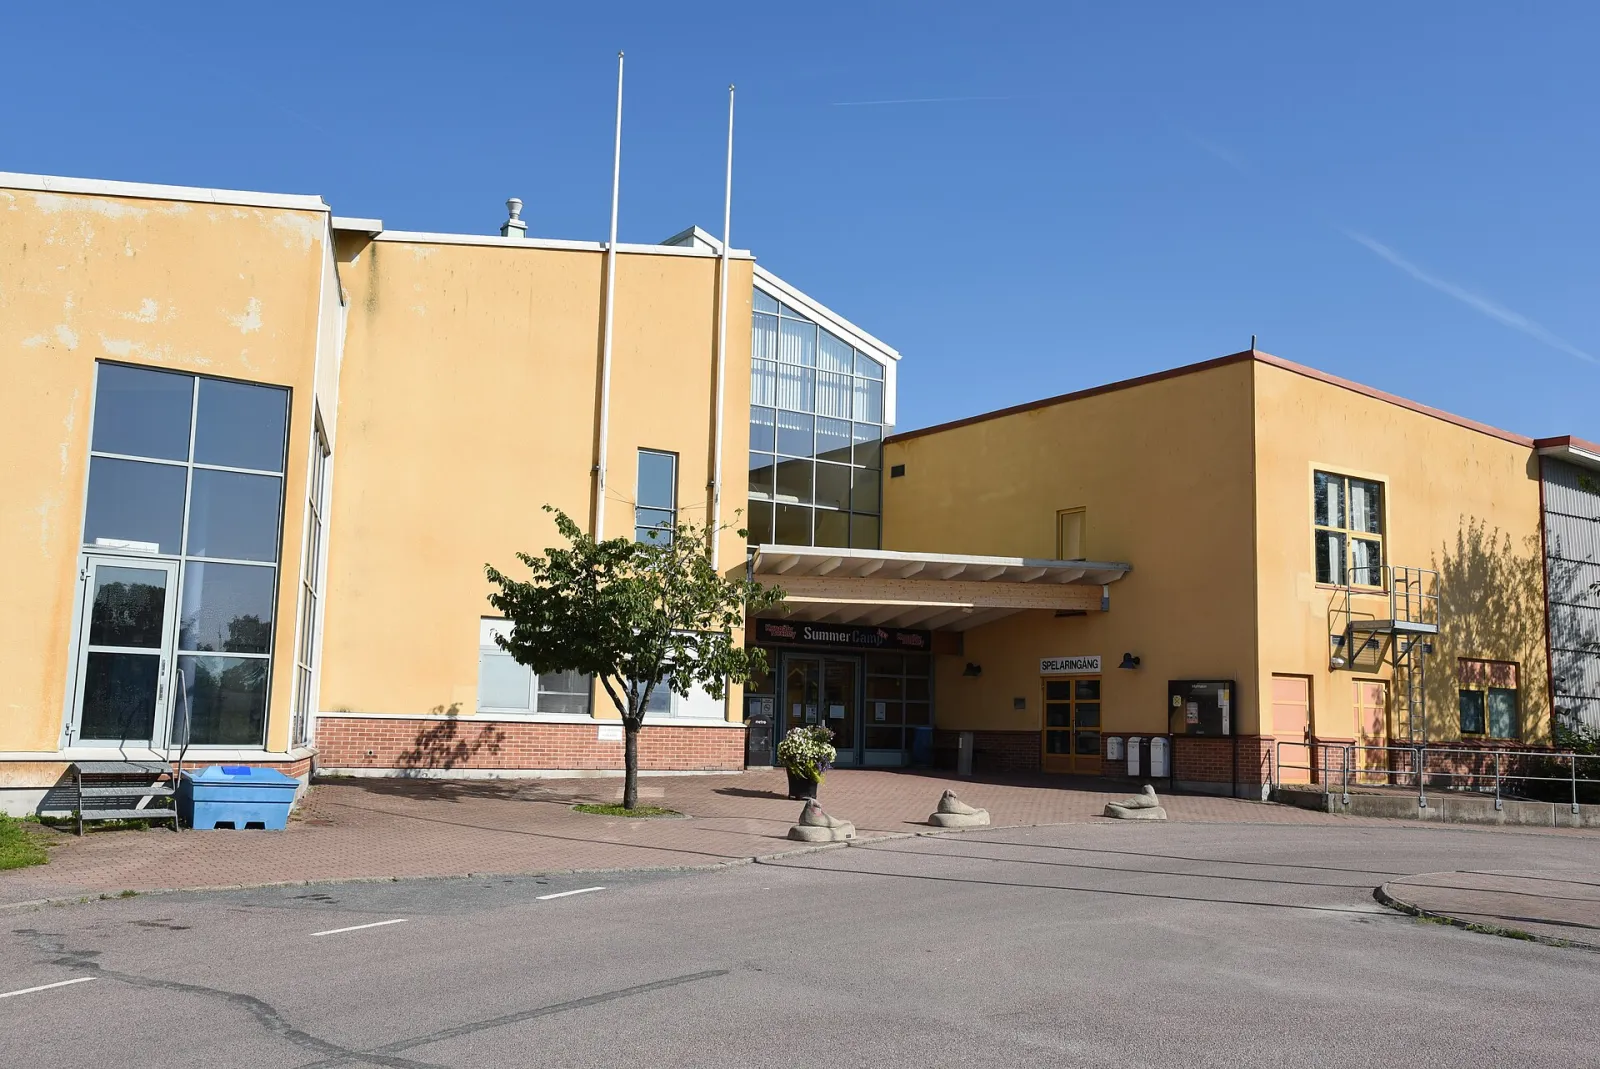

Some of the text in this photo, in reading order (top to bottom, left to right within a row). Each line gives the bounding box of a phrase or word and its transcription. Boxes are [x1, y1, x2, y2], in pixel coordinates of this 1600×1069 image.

[803, 626, 851, 643] Summer
[852, 630, 883, 647] Camp
[1041, 657, 1099, 671] SPELARINGÅNG
